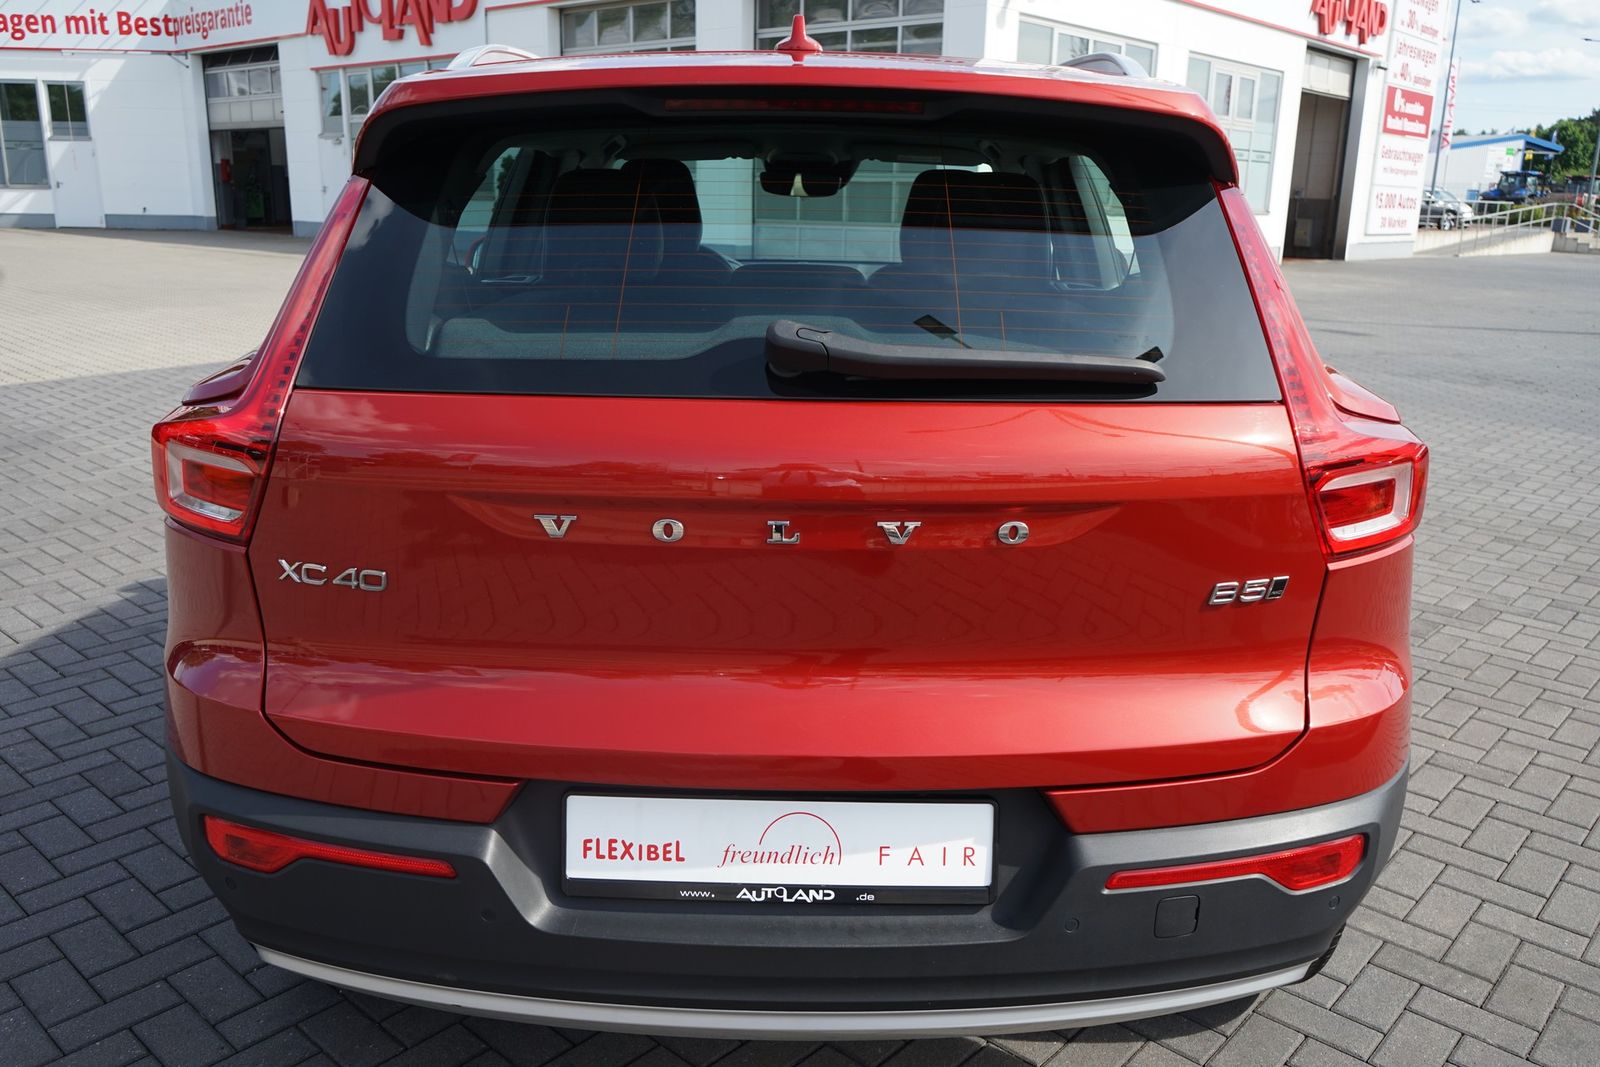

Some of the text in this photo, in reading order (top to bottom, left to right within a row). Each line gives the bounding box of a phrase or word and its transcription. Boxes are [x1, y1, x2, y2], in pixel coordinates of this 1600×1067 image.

[65, 9, 109, 35] mit
[534, 514, 1029, 545] VOLVO
[582, 837, 686, 863] FLEXIBEL
[717, 844, 836, 869] freundlich
[879, 846, 977, 868] FAIR
[679, 887, 875, 903] www. AUTOLAND .de
